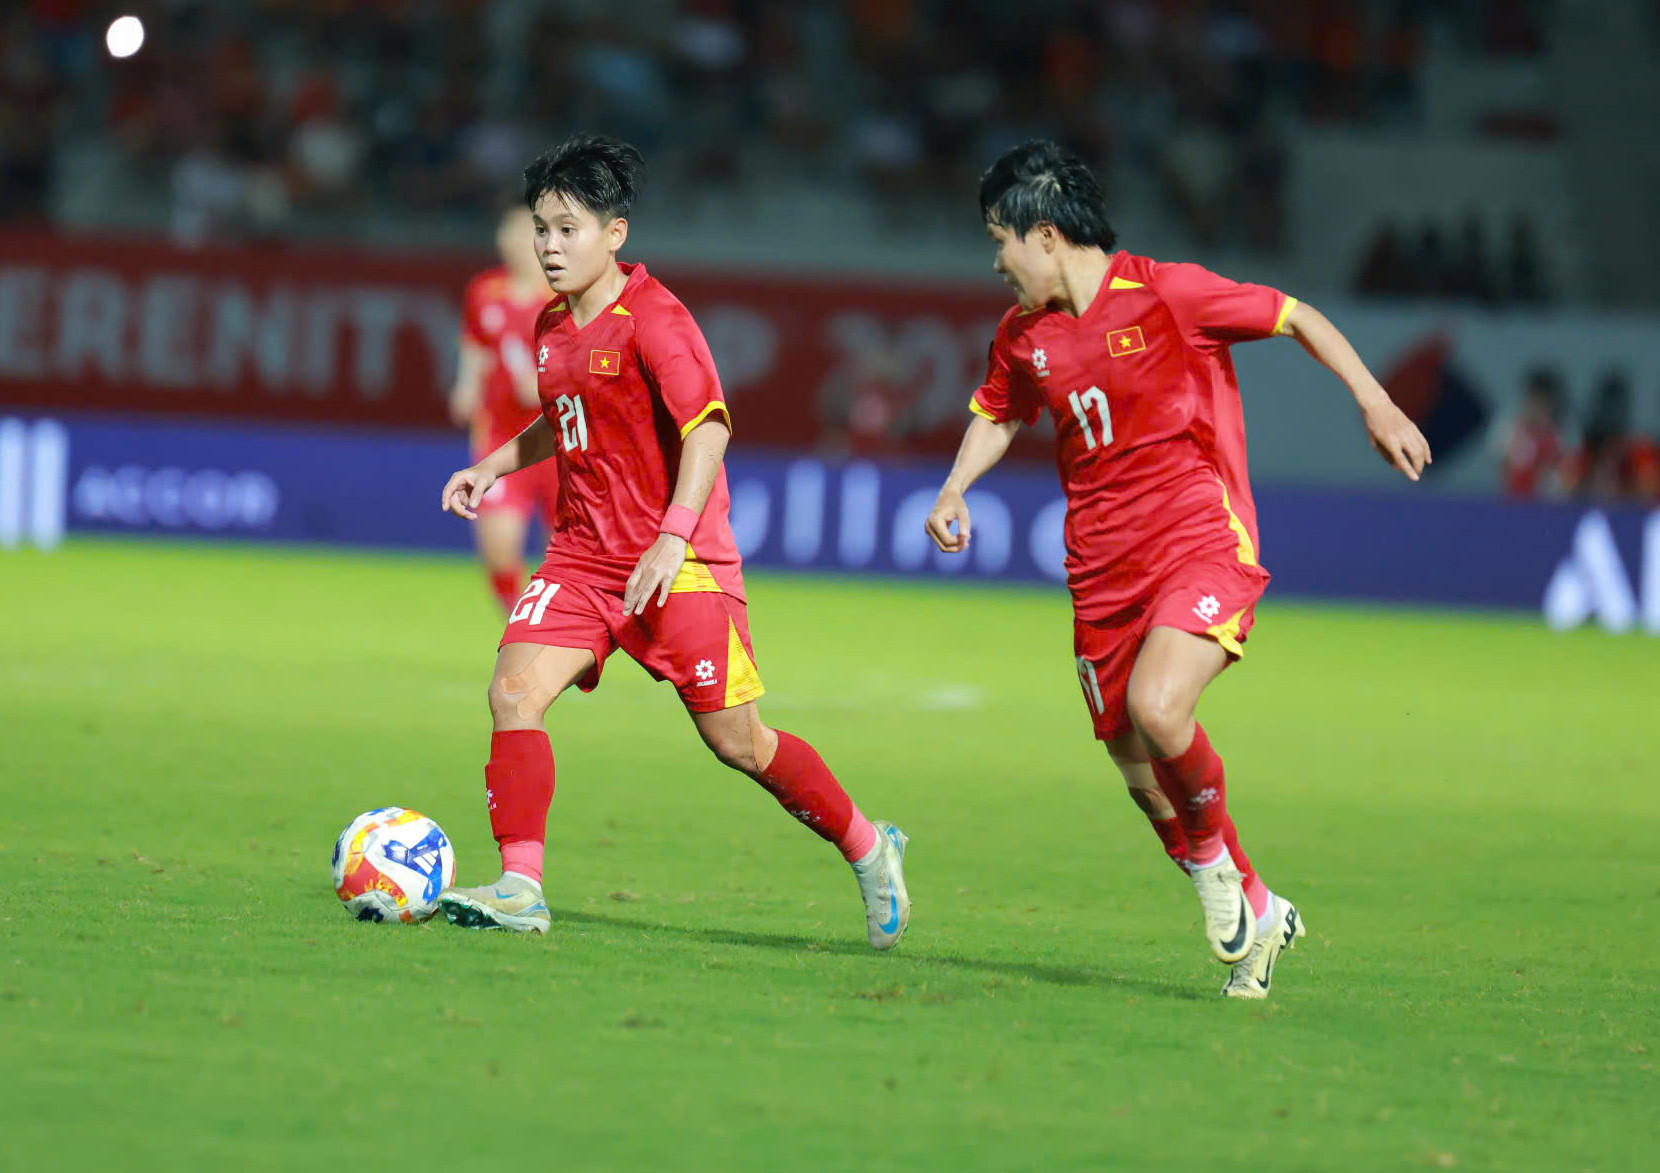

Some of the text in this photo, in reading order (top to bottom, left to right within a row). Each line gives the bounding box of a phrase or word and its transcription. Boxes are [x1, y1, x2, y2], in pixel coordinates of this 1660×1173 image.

[556, 394, 588, 452] 21
[1068, 385, 1114, 450] 17
[509, 578, 561, 625] 21
